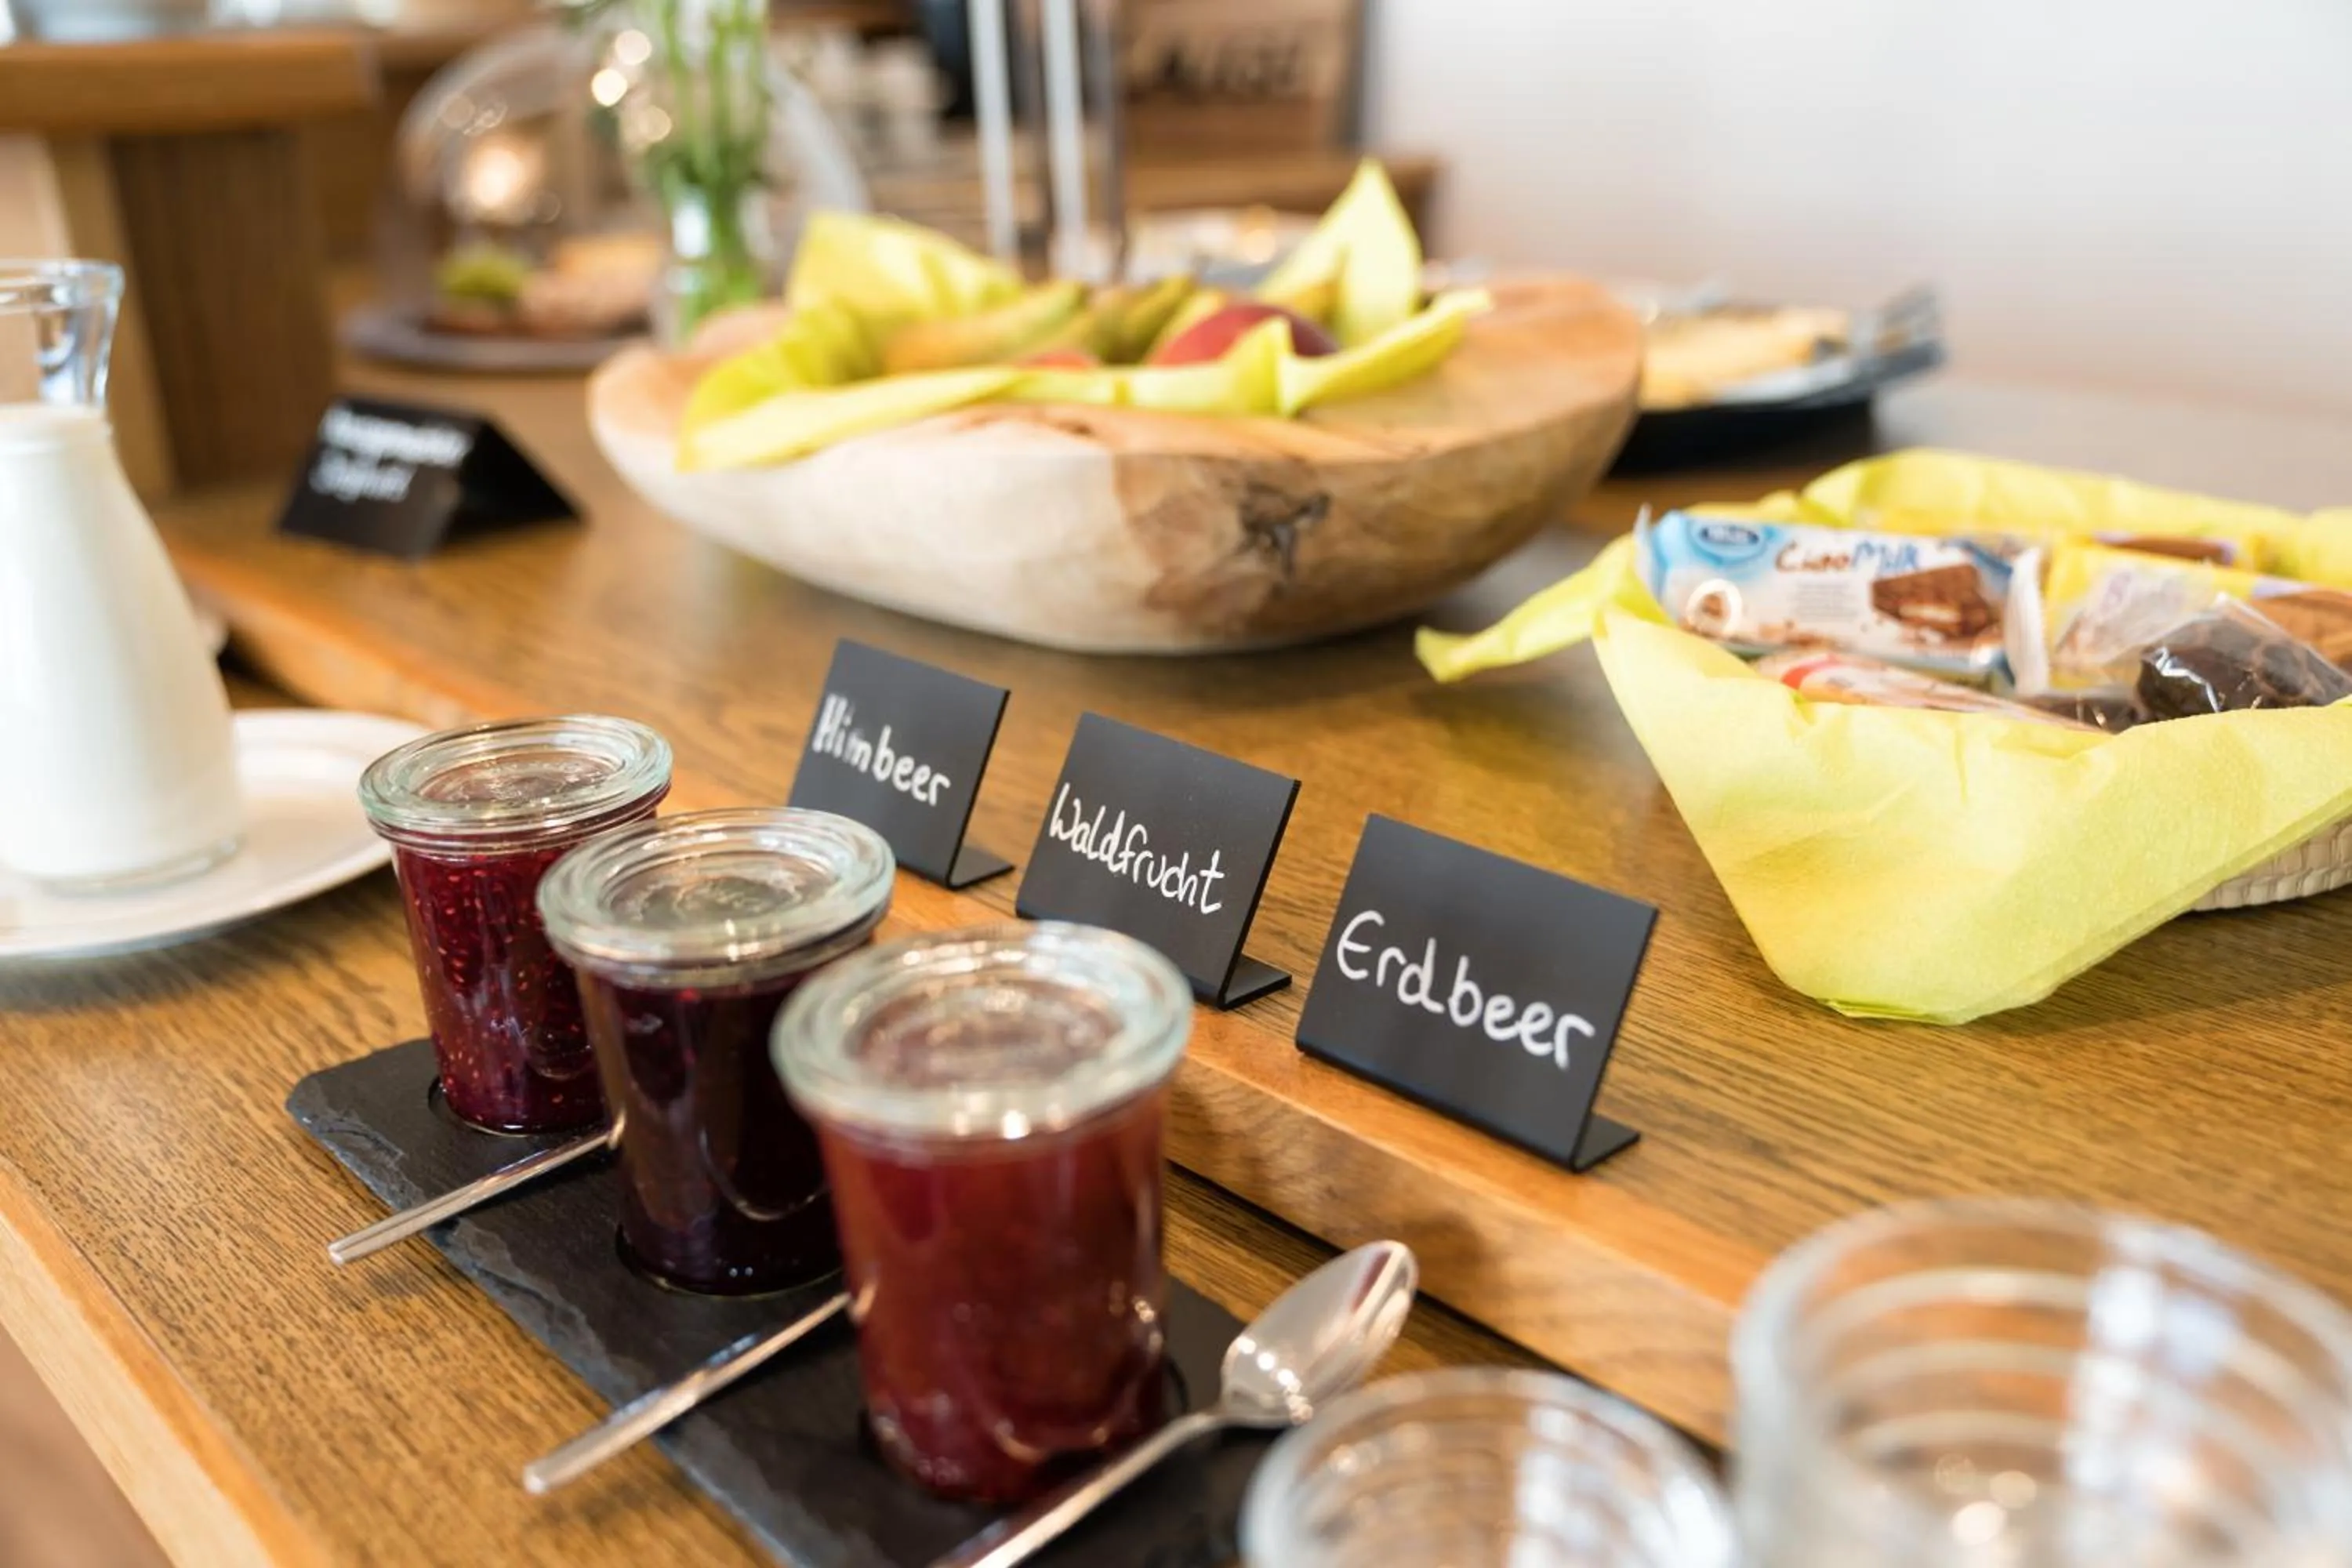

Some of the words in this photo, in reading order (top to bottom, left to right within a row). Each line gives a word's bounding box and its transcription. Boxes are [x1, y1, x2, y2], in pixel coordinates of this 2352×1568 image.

[812, 693, 951, 807] Himbeer
[1048, 782, 1225, 915] Waldfrucht
[1337, 910, 1595, 1070] Erdbeer
